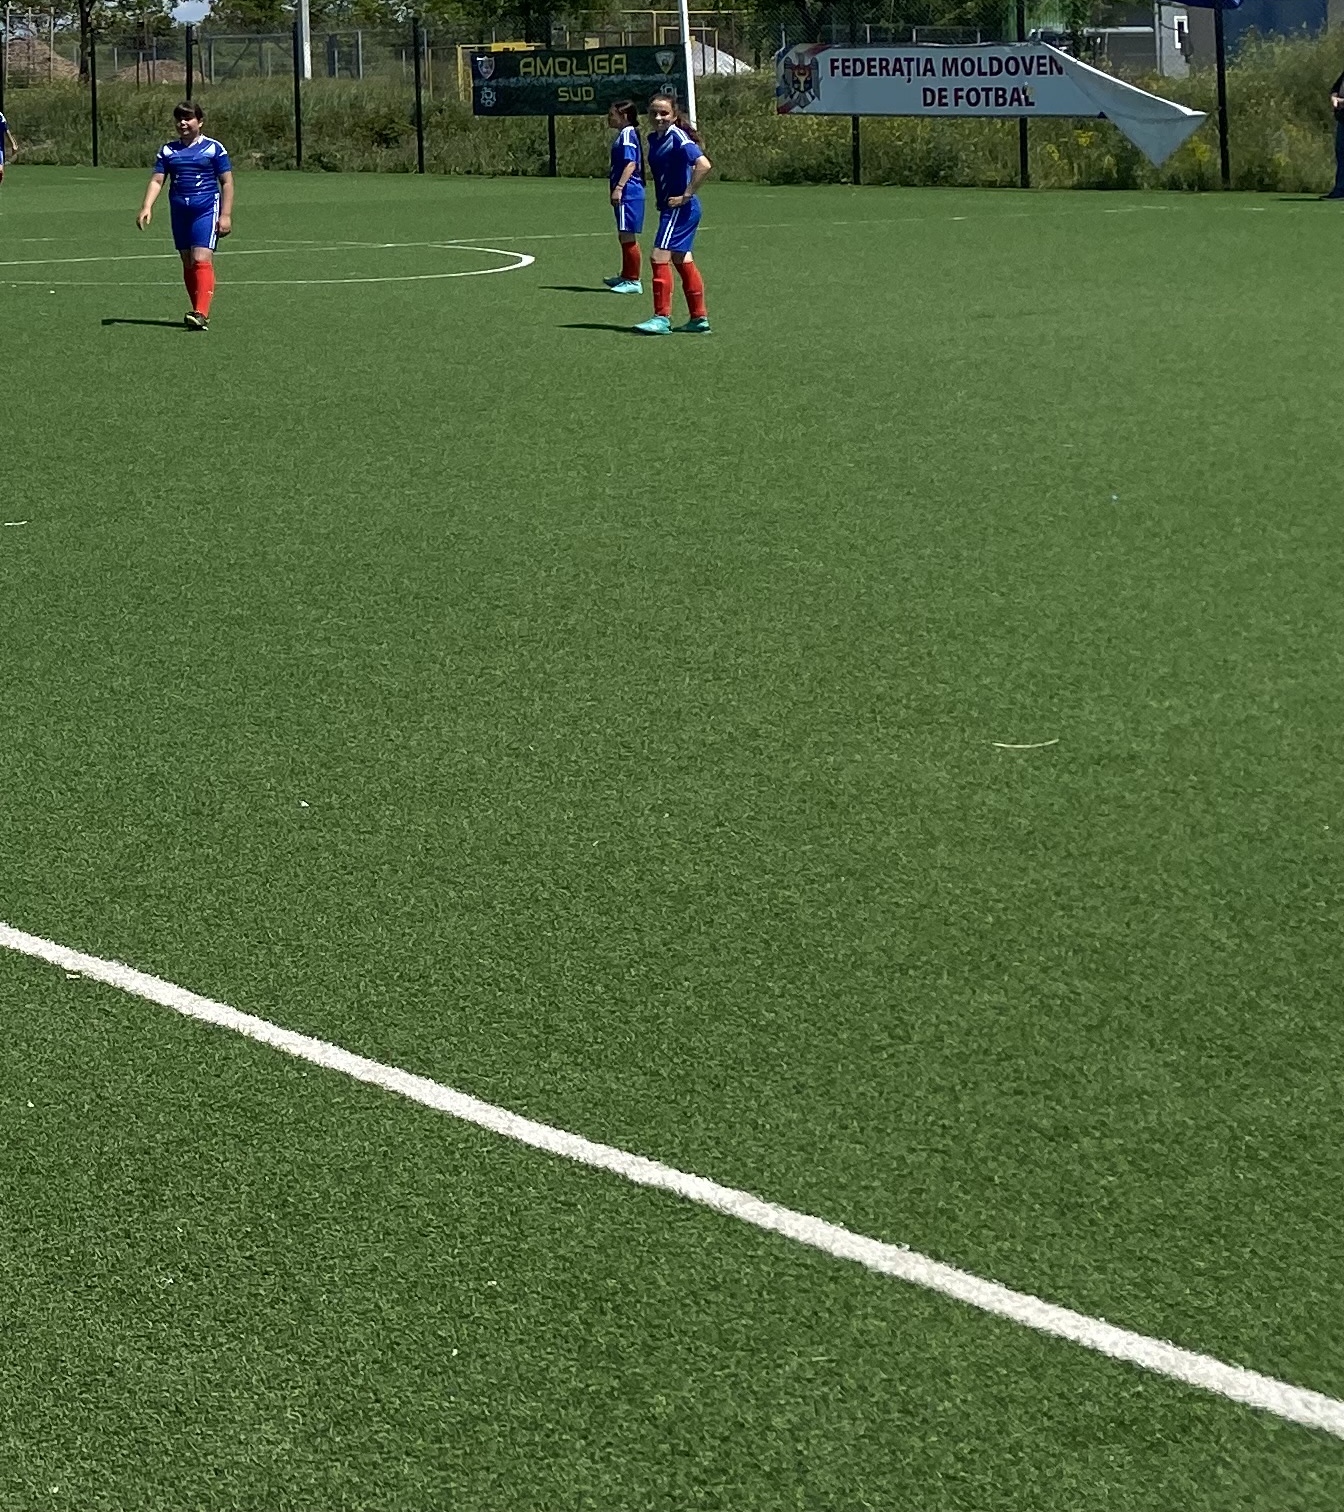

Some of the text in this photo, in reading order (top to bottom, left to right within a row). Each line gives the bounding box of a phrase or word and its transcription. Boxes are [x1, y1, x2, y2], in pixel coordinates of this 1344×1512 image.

[519, 54, 628, 77] AMOLIGA
[829, 56, 936, 84] FEDERAȚIA
[557, 86, 595, 102] SUD
[921, 85, 1036, 107] DE FOTBAL
